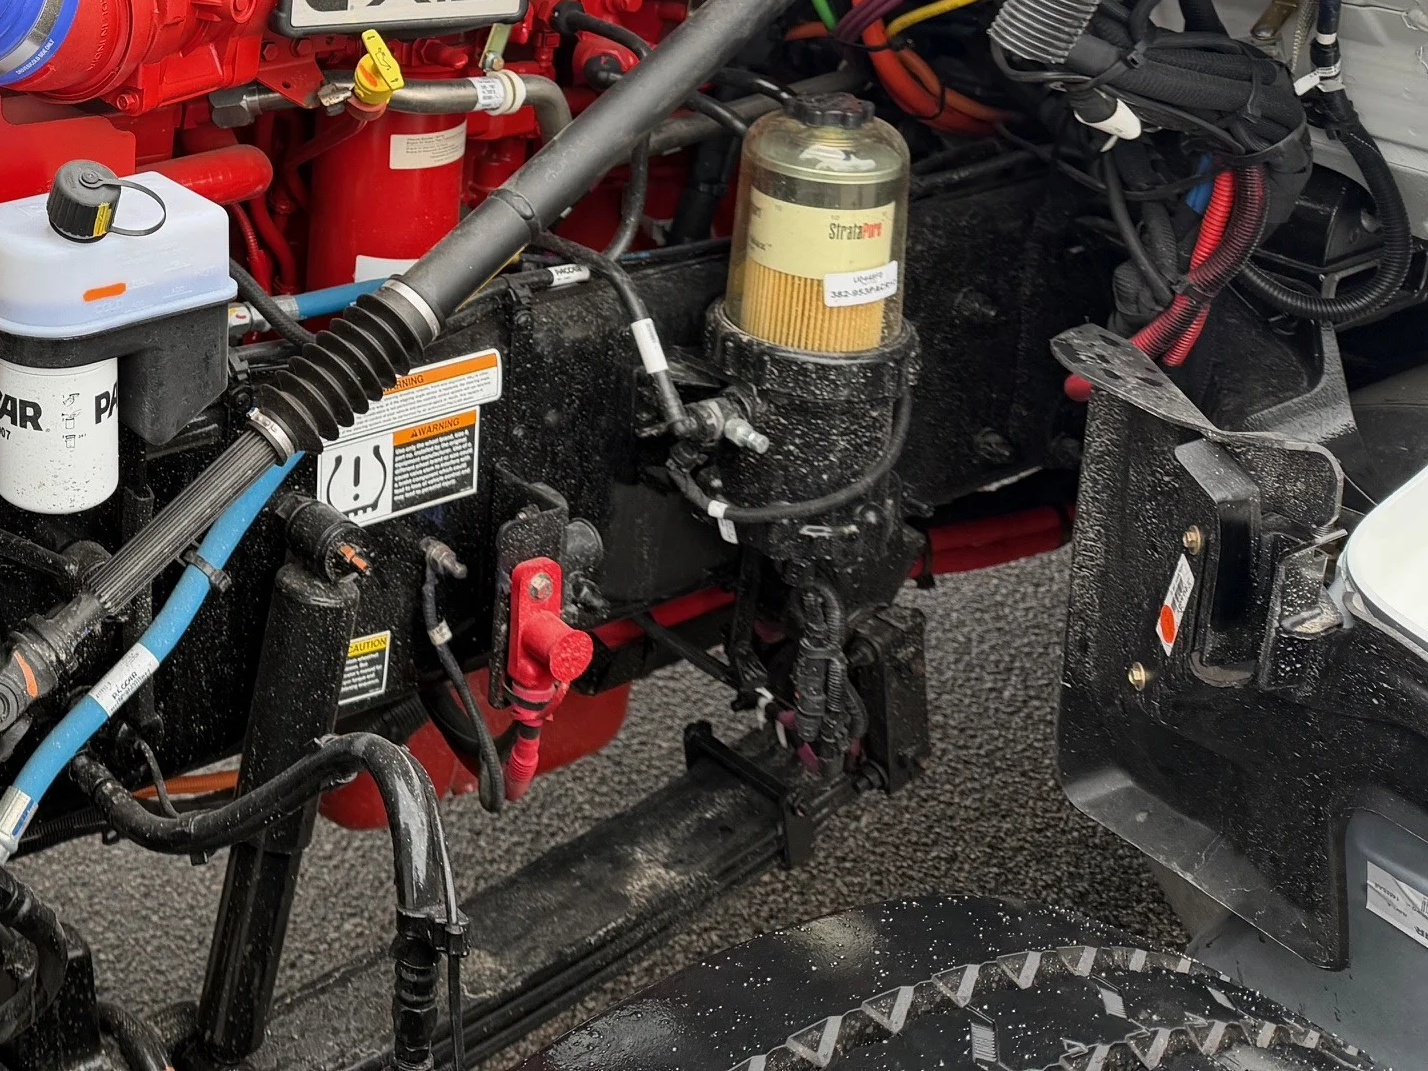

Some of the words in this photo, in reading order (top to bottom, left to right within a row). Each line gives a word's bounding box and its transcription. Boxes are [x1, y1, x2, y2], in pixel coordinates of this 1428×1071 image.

[384, 374, 424, 394] ARNING
[416, 418, 460, 437] WARNING
[349, 638, 386, 653] CAUTION
